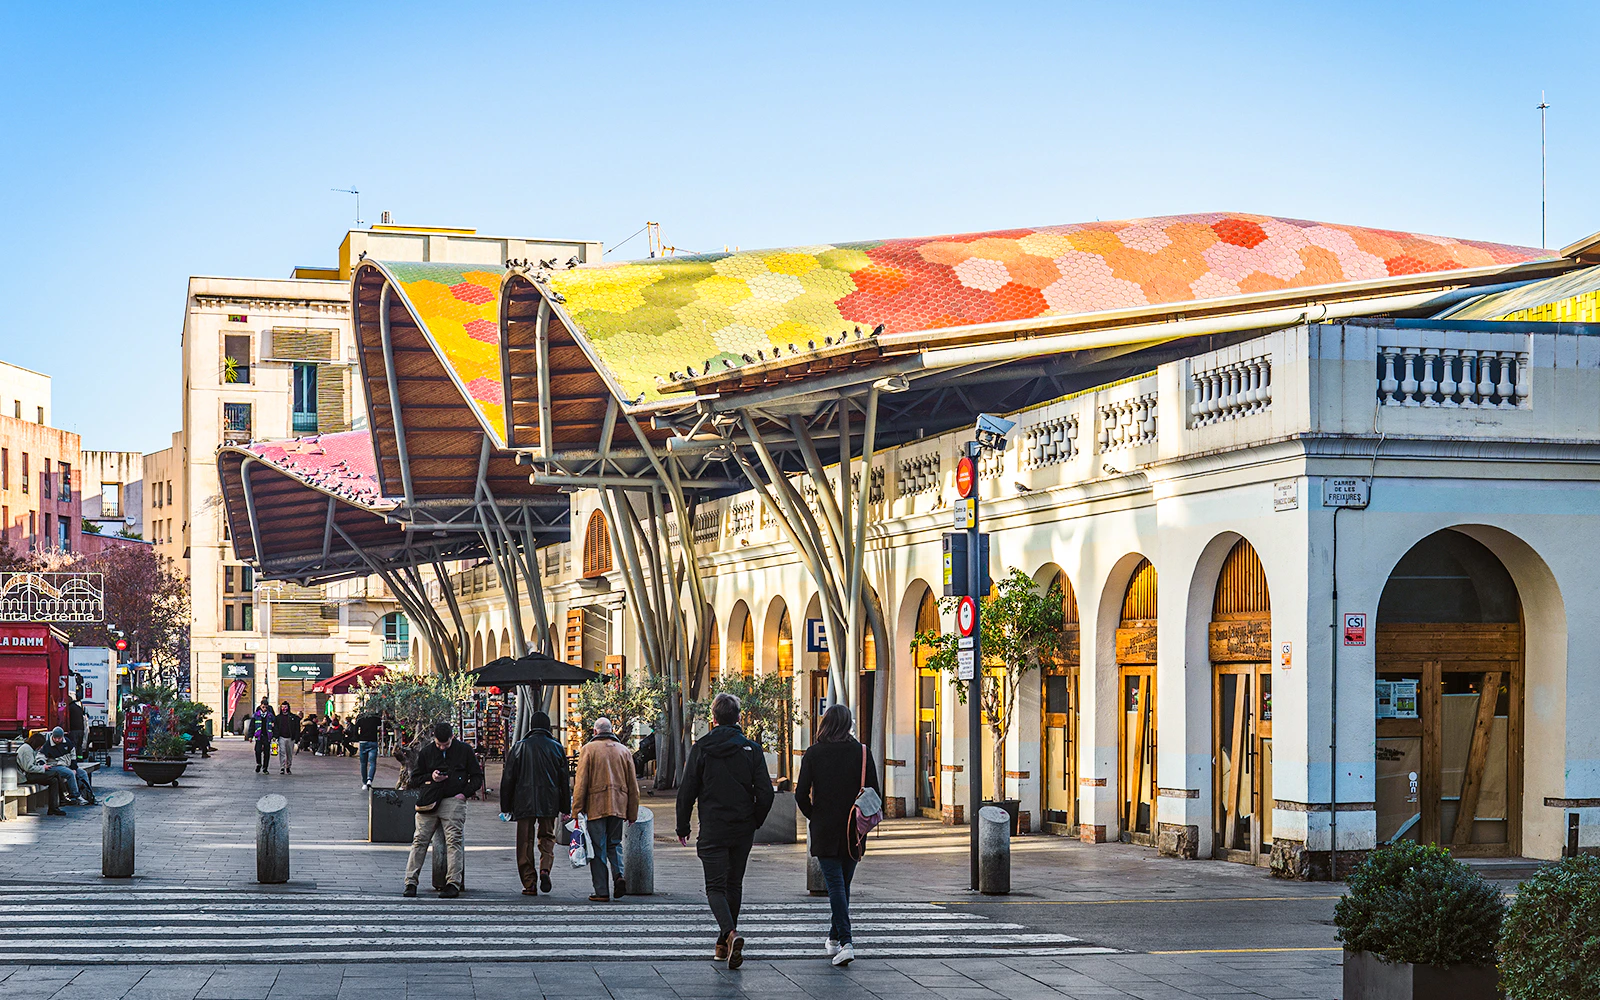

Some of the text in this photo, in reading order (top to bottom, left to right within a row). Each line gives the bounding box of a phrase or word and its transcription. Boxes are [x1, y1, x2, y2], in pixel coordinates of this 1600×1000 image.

[34, 611, 94, 620] Caterina
[1347, 617, 1363, 628] CSI
[12, 637, 44, 646] DAMM
